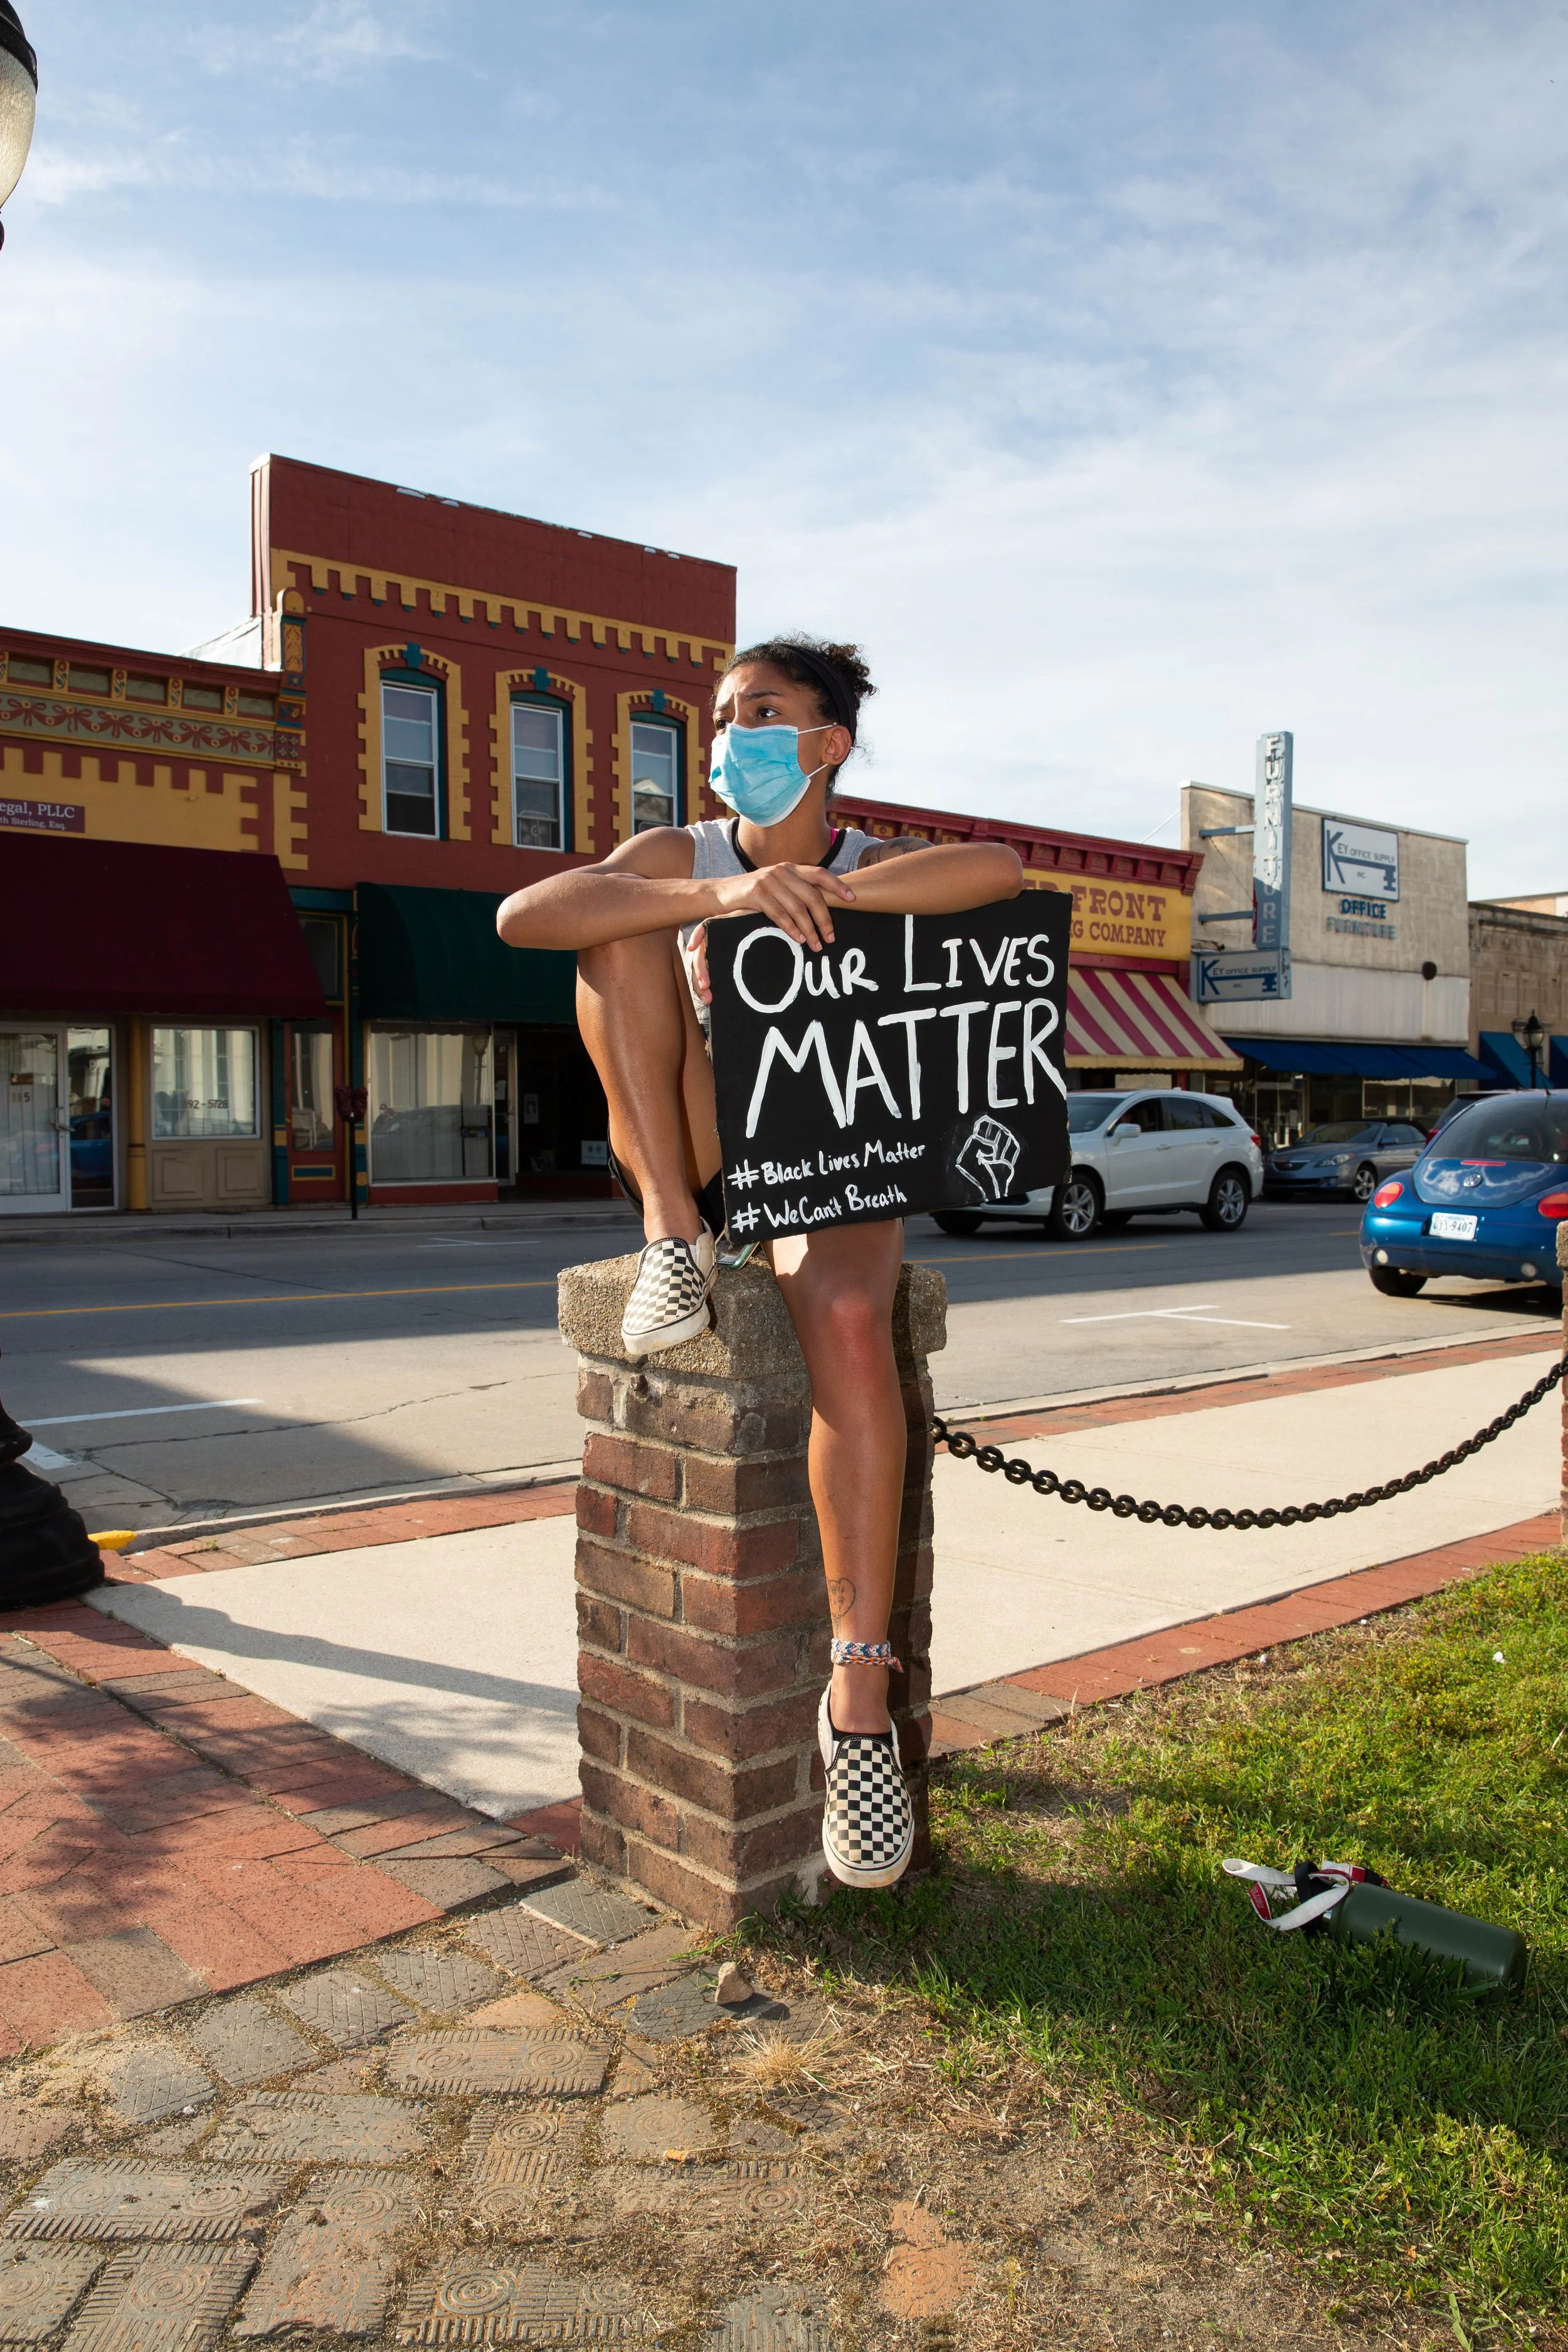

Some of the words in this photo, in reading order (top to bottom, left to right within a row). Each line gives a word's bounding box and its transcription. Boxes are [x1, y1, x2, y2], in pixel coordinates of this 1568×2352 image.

[11, 817, 47, 829] Sterling,
[49, 820, 67, 831] Esq.
[37, 803, 75, 819] PLLC
[1263, 736, 1283, 944] FURNITURE
[1349, 848, 1372, 860] OFFICE
[1374, 852, 1395, 864] SUPPLY
[1070, 884, 1167, 921] FRONT
[1341, 898, 1386, 919] OFFICE
[1089, 921, 1167, 947] COMPANY
[904, 914, 1055, 993] LIVES
[745, 998, 1067, 1139] MATTER
[727, 1159, 815, 1190] #Black
[863, 1139, 926, 1167] Matter
[845, 1184, 908, 1211] Breath
